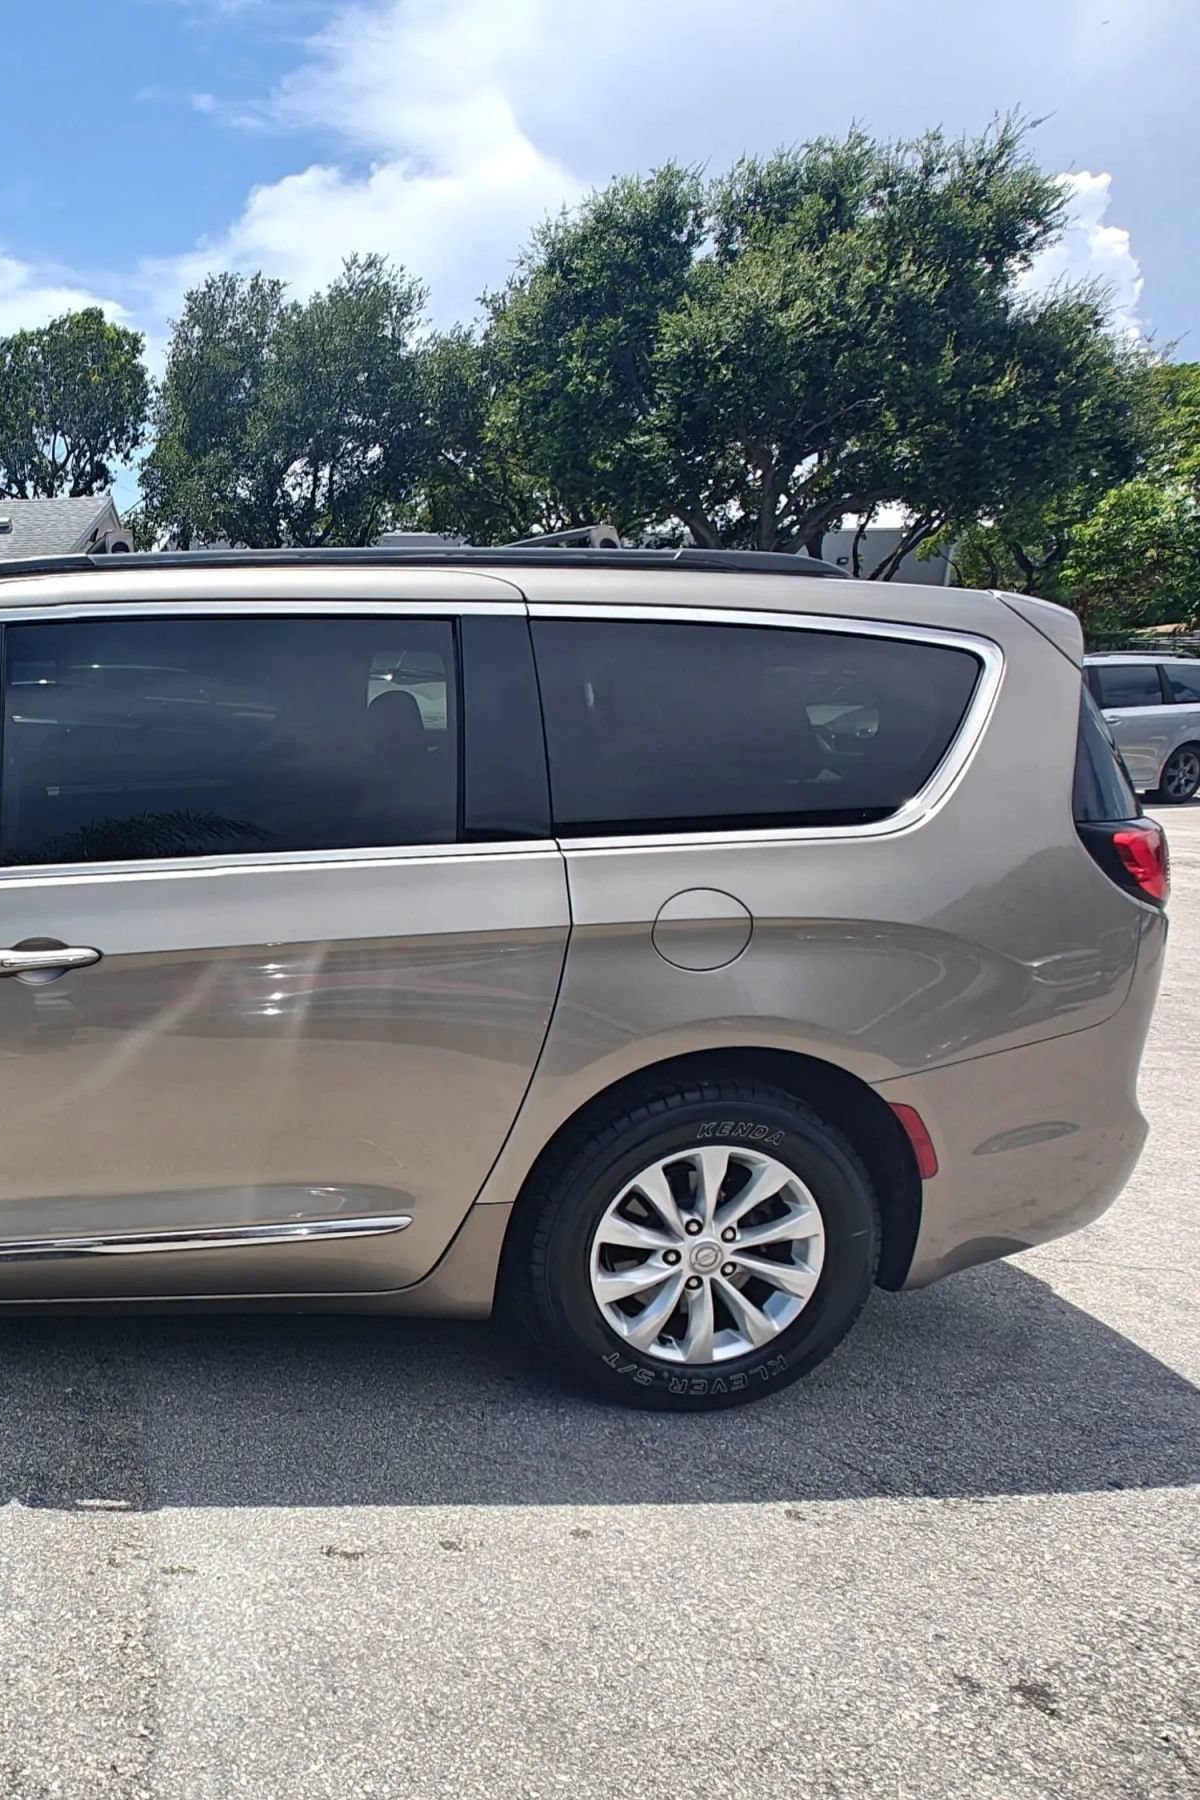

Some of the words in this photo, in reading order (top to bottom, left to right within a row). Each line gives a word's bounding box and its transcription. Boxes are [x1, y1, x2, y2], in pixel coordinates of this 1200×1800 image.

[695, 1121, 786, 1146] KENDA
[601, 1352, 656, 1386] S/T
[668, 1354, 789, 1395] KLEVER
